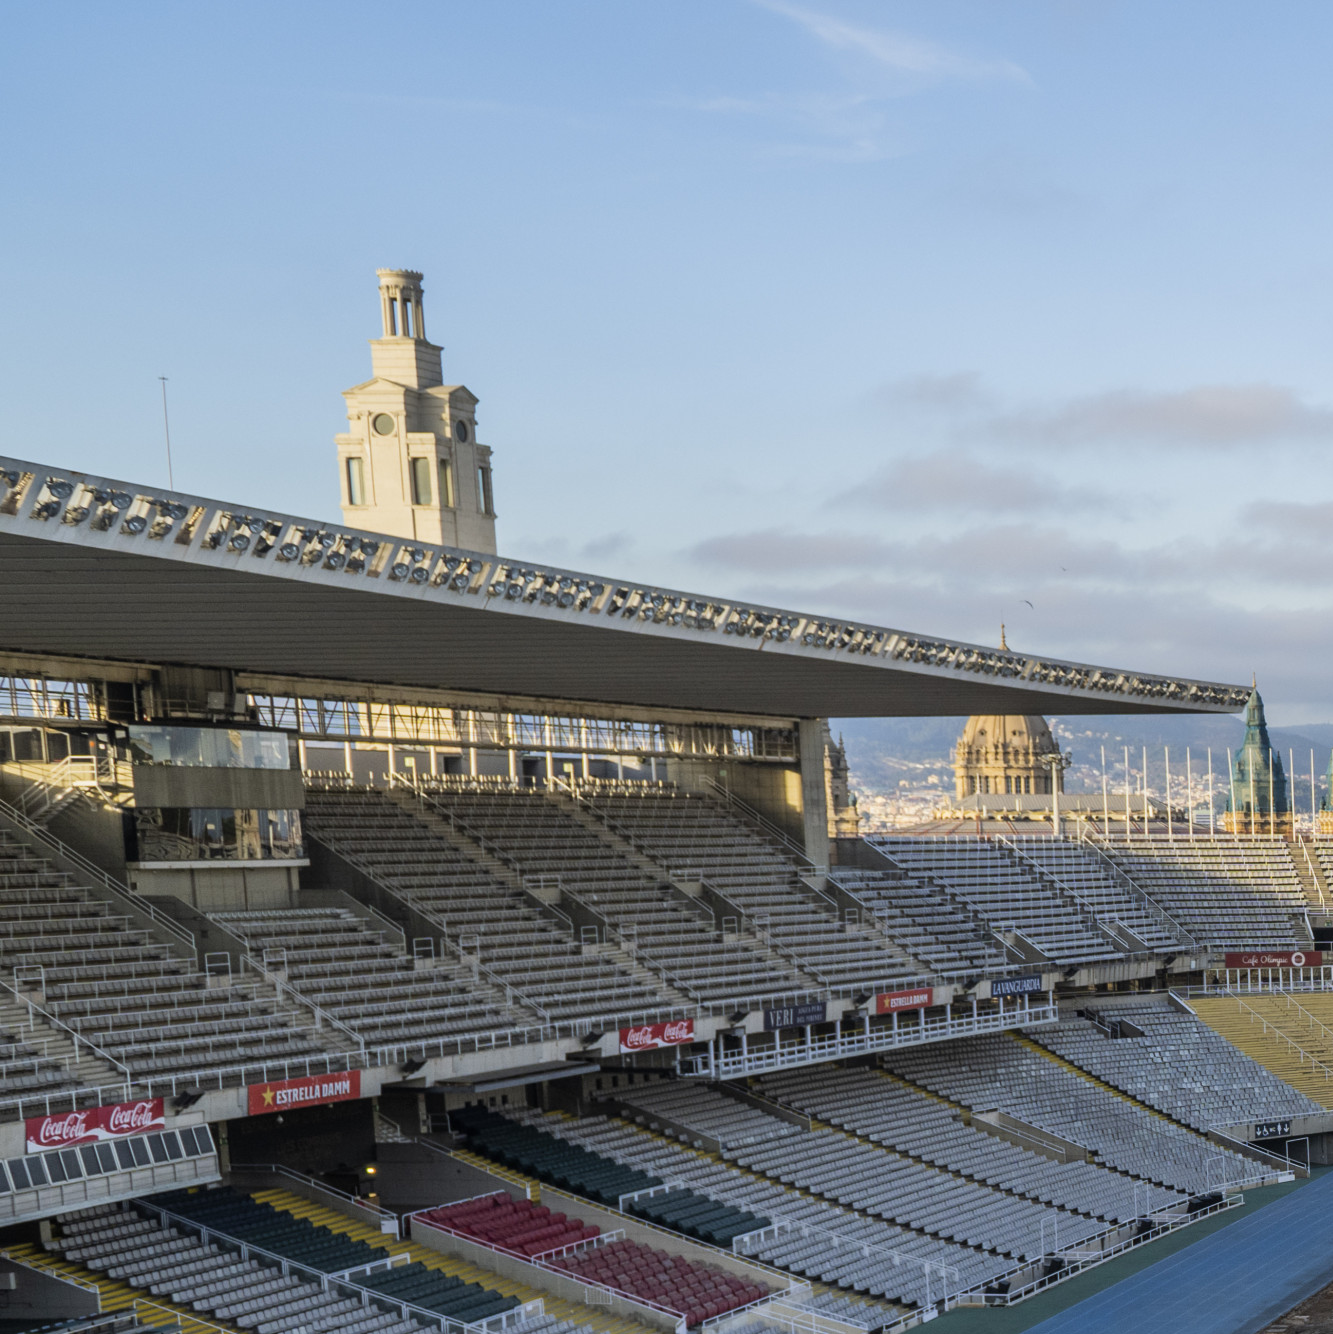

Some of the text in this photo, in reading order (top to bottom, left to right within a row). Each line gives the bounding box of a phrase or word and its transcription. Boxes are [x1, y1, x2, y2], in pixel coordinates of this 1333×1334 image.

[890, 993, 928, 1008] ESTRELLA DAMM
[769, 1008, 794, 1027] VERI
[276, 1080, 350, 1104] ESTRELLA DAMM
